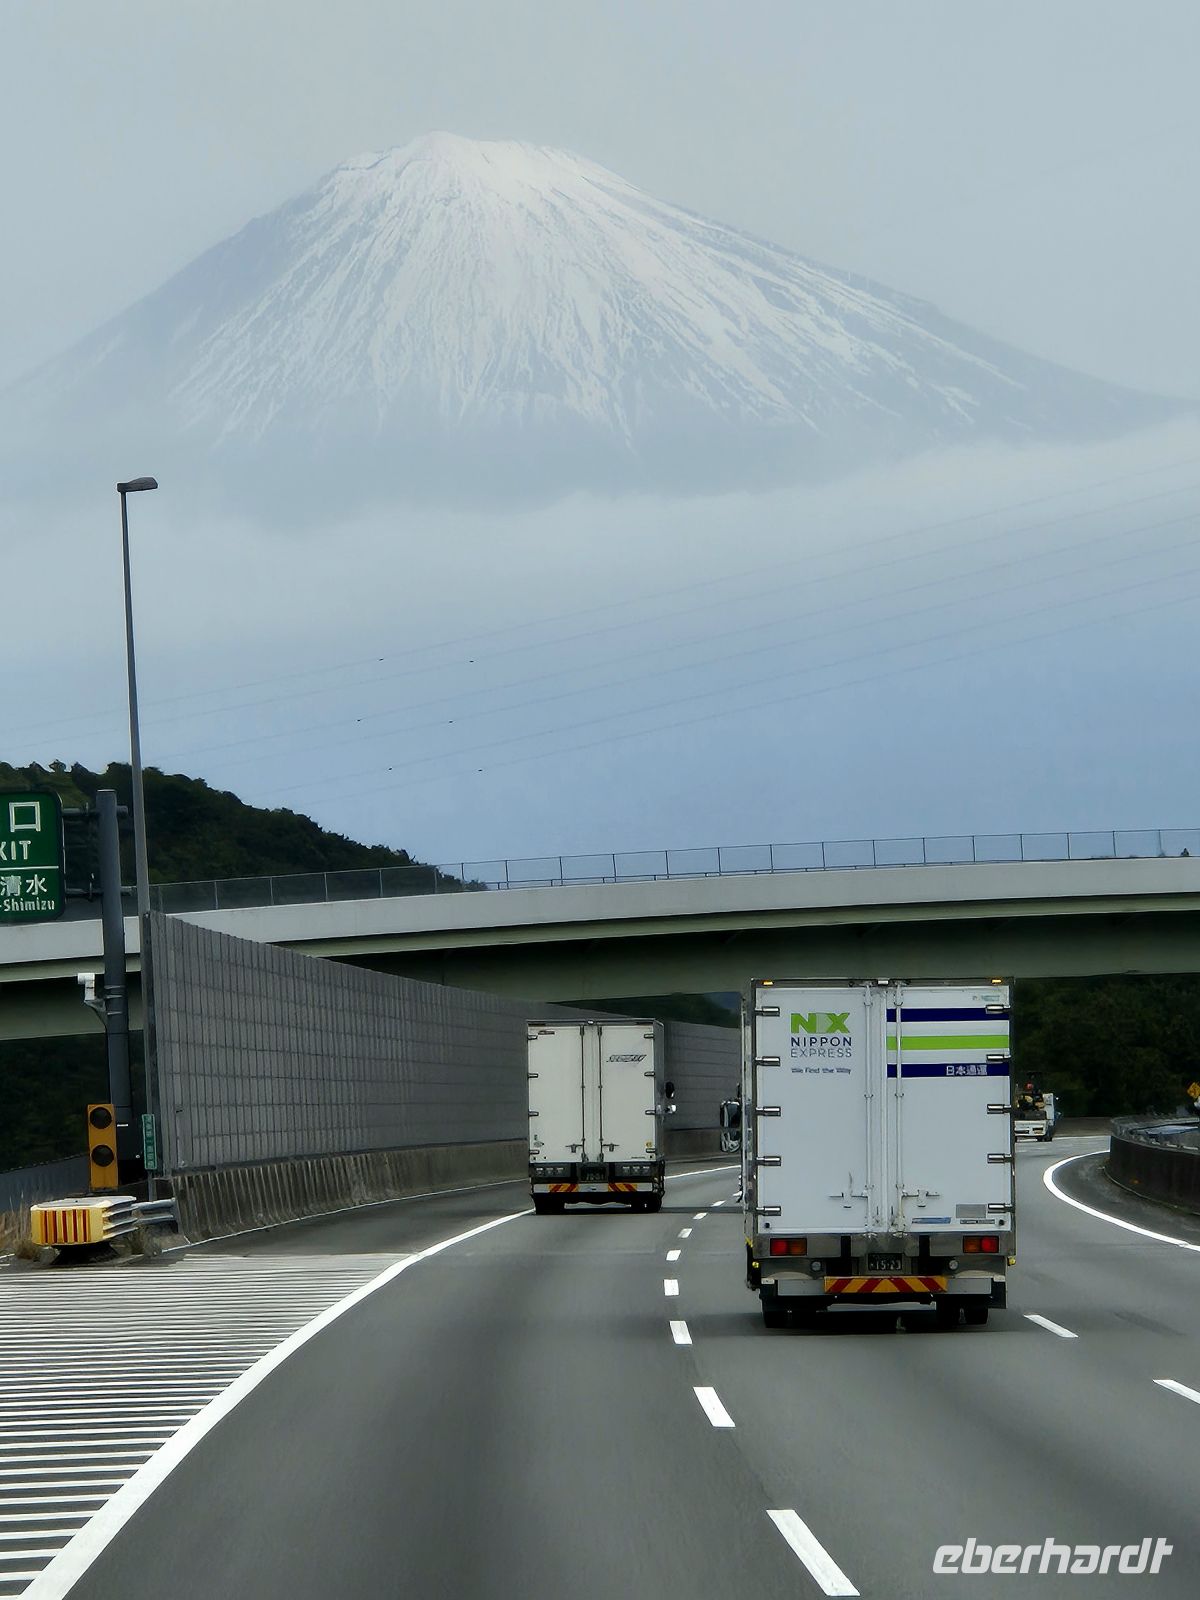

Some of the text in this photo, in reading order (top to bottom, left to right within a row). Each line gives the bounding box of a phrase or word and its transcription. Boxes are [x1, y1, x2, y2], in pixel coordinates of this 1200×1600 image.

[9, 801, 41, 832] 口
[0, 874, 47, 896] 清水
[791, 1012, 850, 1034] NX
[791, 1037, 851, 1047] NIPPON
[791, 1048, 851, 1058] EXPRESS
